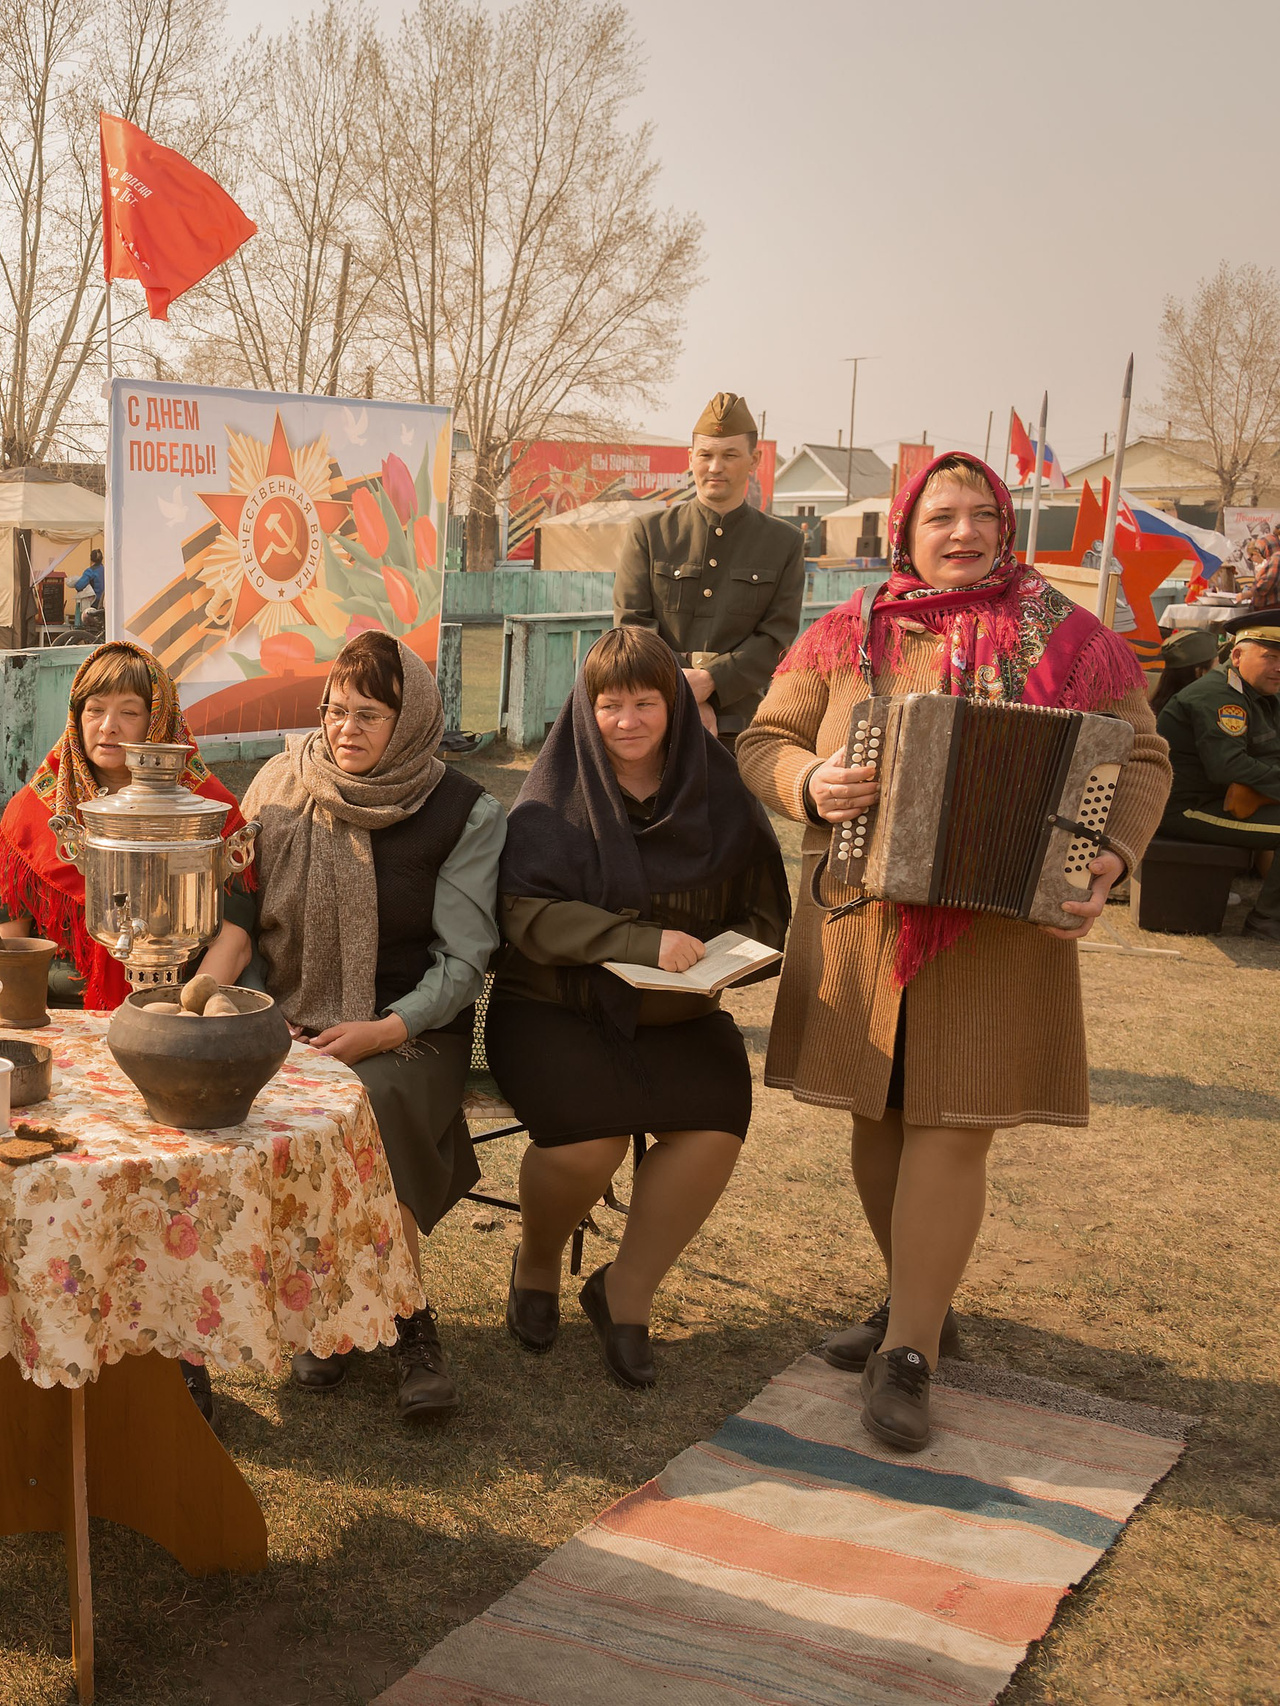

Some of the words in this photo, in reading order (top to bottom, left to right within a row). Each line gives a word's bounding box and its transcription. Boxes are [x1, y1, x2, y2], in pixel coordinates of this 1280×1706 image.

[120, 171, 152, 199] ОРДЕНА
[128, 395, 139, 427] С
[146, 397, 200, 432] ДНЕМ
[130, 440, 217, 477] ПОБЕДЫ!
[242, 480, 313, 588] ОТЕЧЕСТВЕННАЯ
